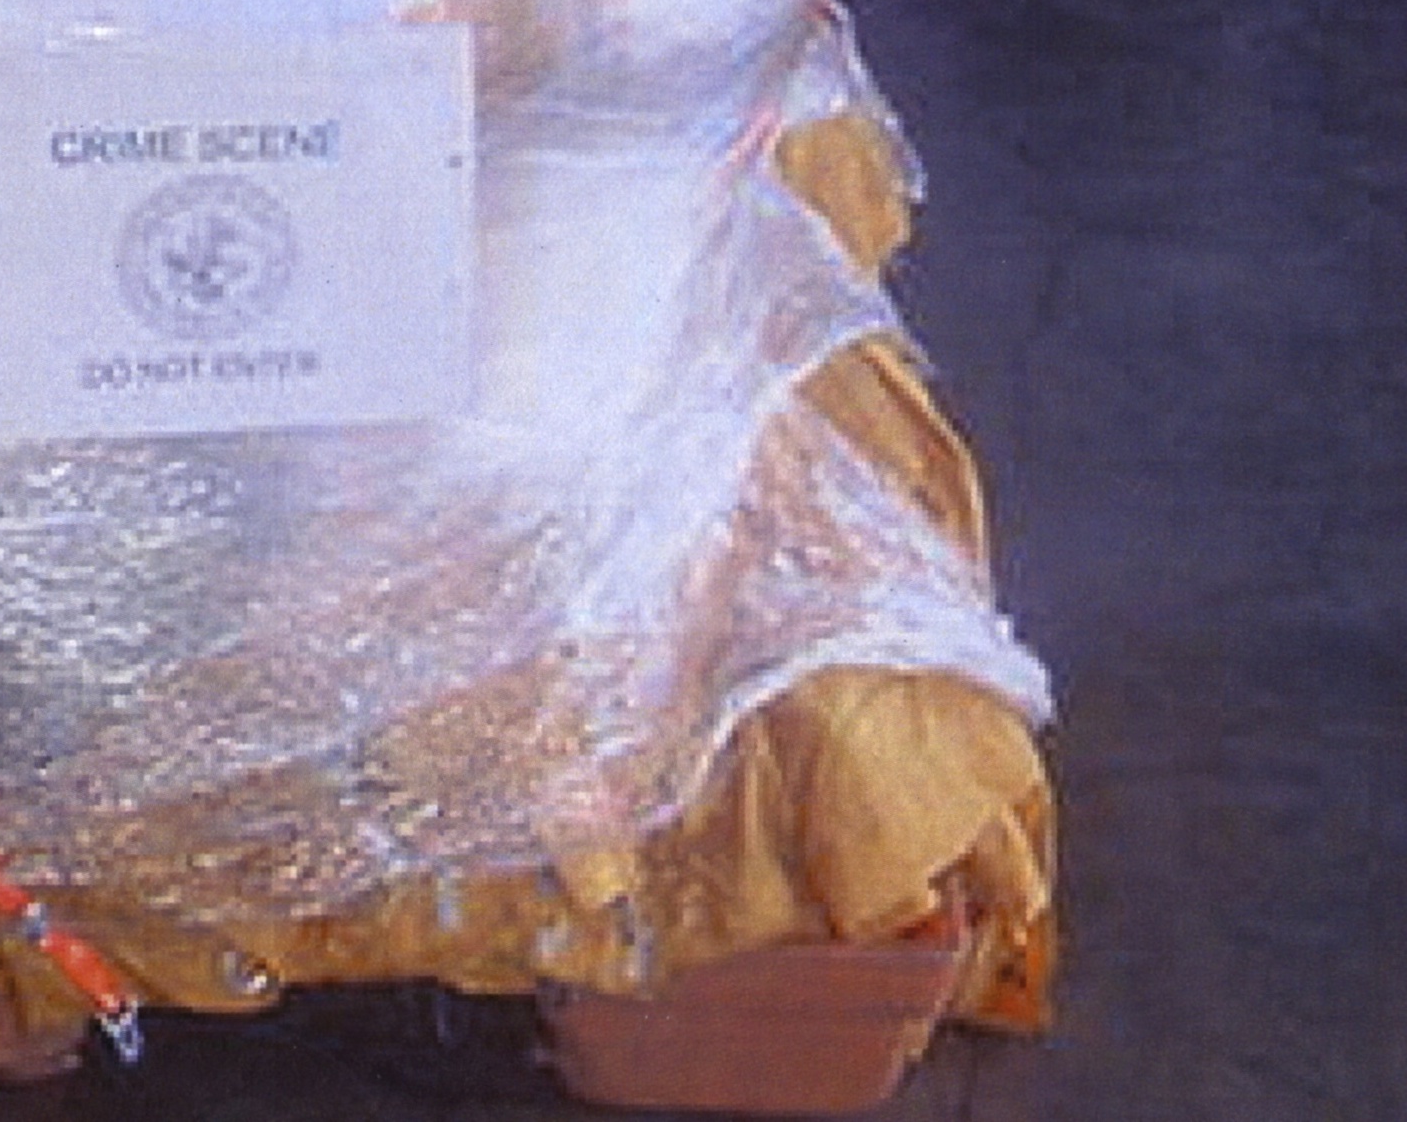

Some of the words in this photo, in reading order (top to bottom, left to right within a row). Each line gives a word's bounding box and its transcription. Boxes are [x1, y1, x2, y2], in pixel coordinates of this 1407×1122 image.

[50, 128, 190, 166] CRIME
[197, 121, 340, 163] SCENE
[81, 354, 132, 390] DO
[136, 351, 202, 384] NOT
